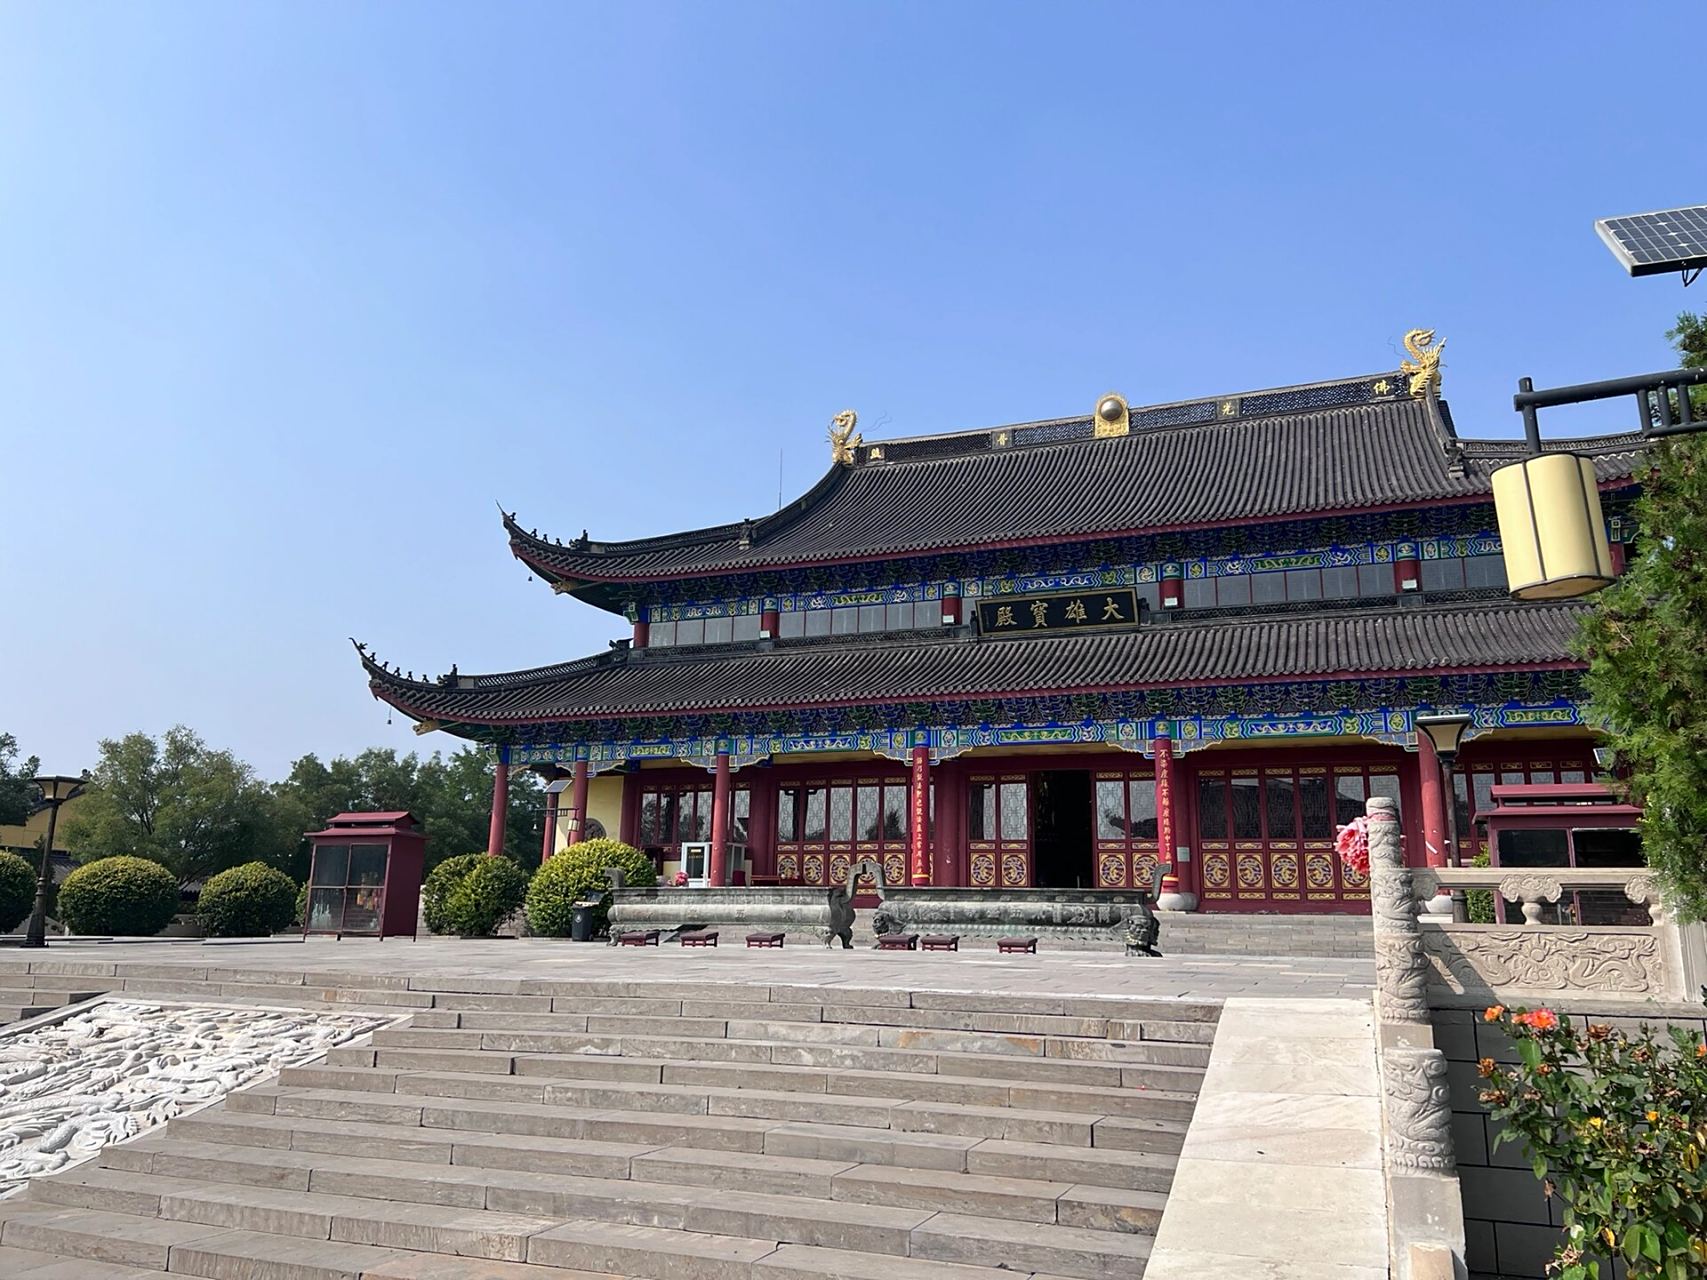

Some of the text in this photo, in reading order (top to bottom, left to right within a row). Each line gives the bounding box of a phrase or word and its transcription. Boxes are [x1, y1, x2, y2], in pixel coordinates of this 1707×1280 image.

[1373, 379, 1390, 395] 佛
[1222, 402, 1235, 416] 光
[994, 596, 1125, 629] 大雄寶殿
